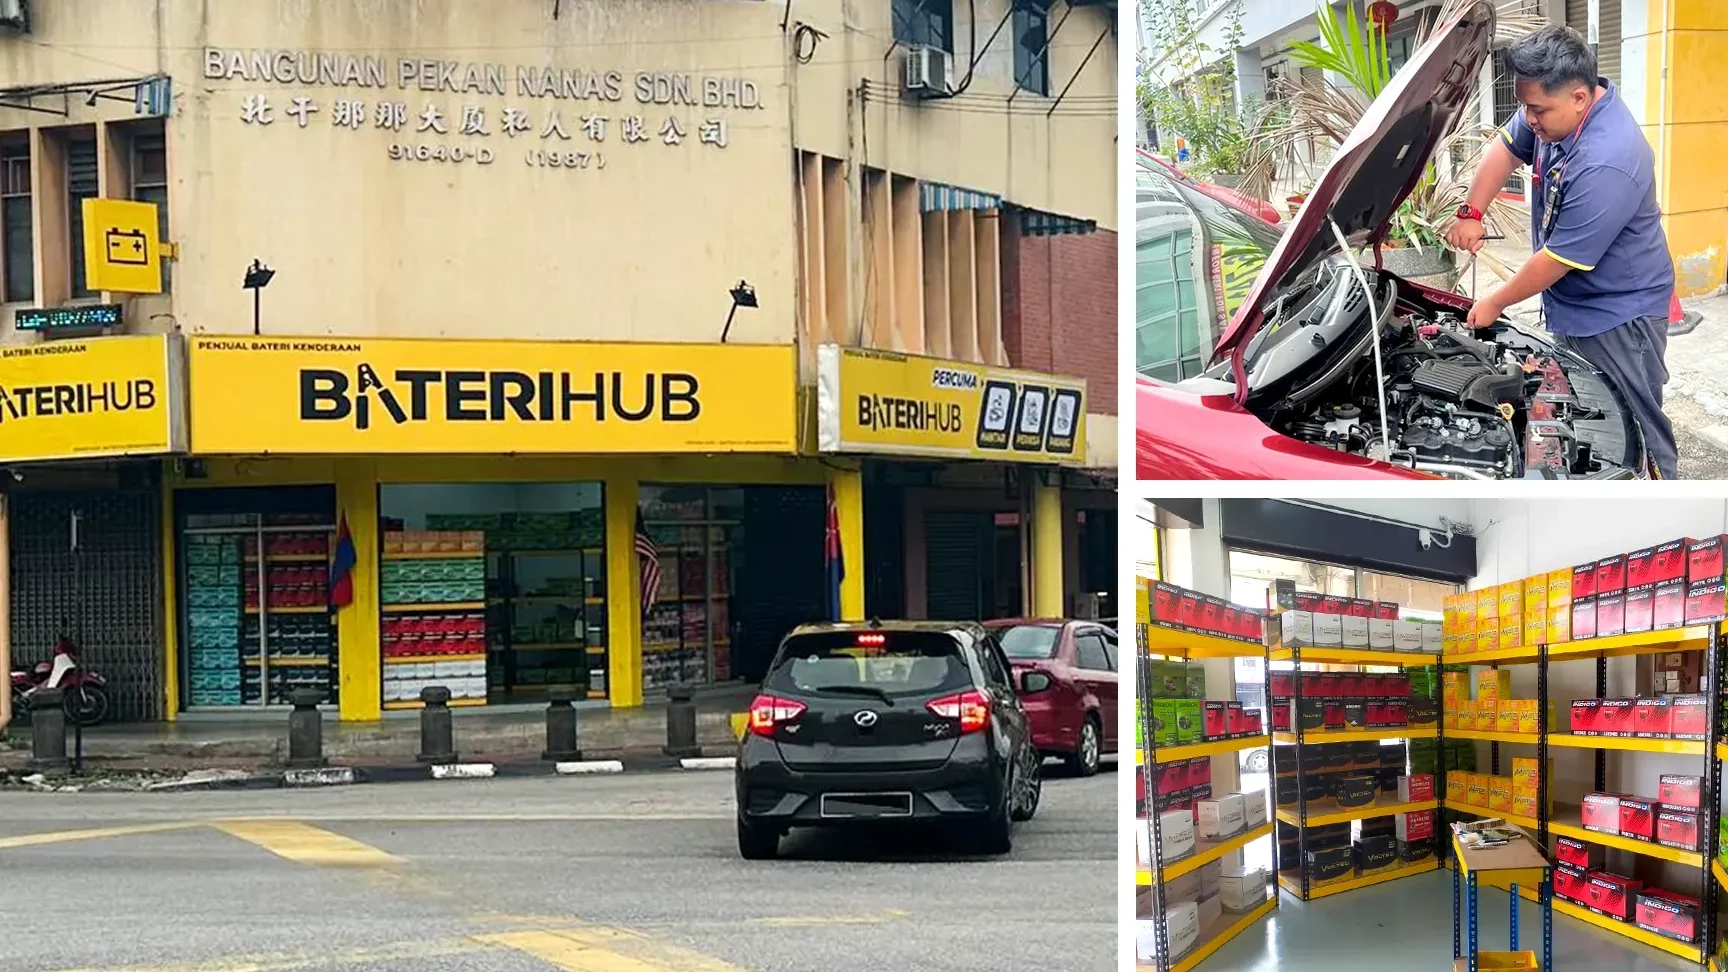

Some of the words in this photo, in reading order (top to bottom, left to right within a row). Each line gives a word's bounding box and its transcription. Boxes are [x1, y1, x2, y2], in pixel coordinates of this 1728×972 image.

[203, 47, 386, 88] BANGUNAN
[399, 58, 505, 95] PEKAN
[516, 66, 622, 103] NANAS
[387, 143, 494, 165] 91640-D
[524, 150, 607, 169] (1987)
[198, 341, 249, 350] PENJUAL
[251, 342, 290, 351] BATERI
[293, 343, 361, 352] KENDERAAN
[932, 369, 977, 389] PERCUMA
[300, 363, 700, 429] BATERIHUB
[858, 394, 961, 432] BATERIHUB
[1688, 585, 1726, 598] INDIGO
[1661, 776, 1693, 786] INDIGO
[1620, 800, 1648, 810] INDIGO
[1659, 813, 1691, 822] INDIGO
[1367, 852, 1395, 863] VOLTEC
[1644, 899, 1680, 914] INDIGO
